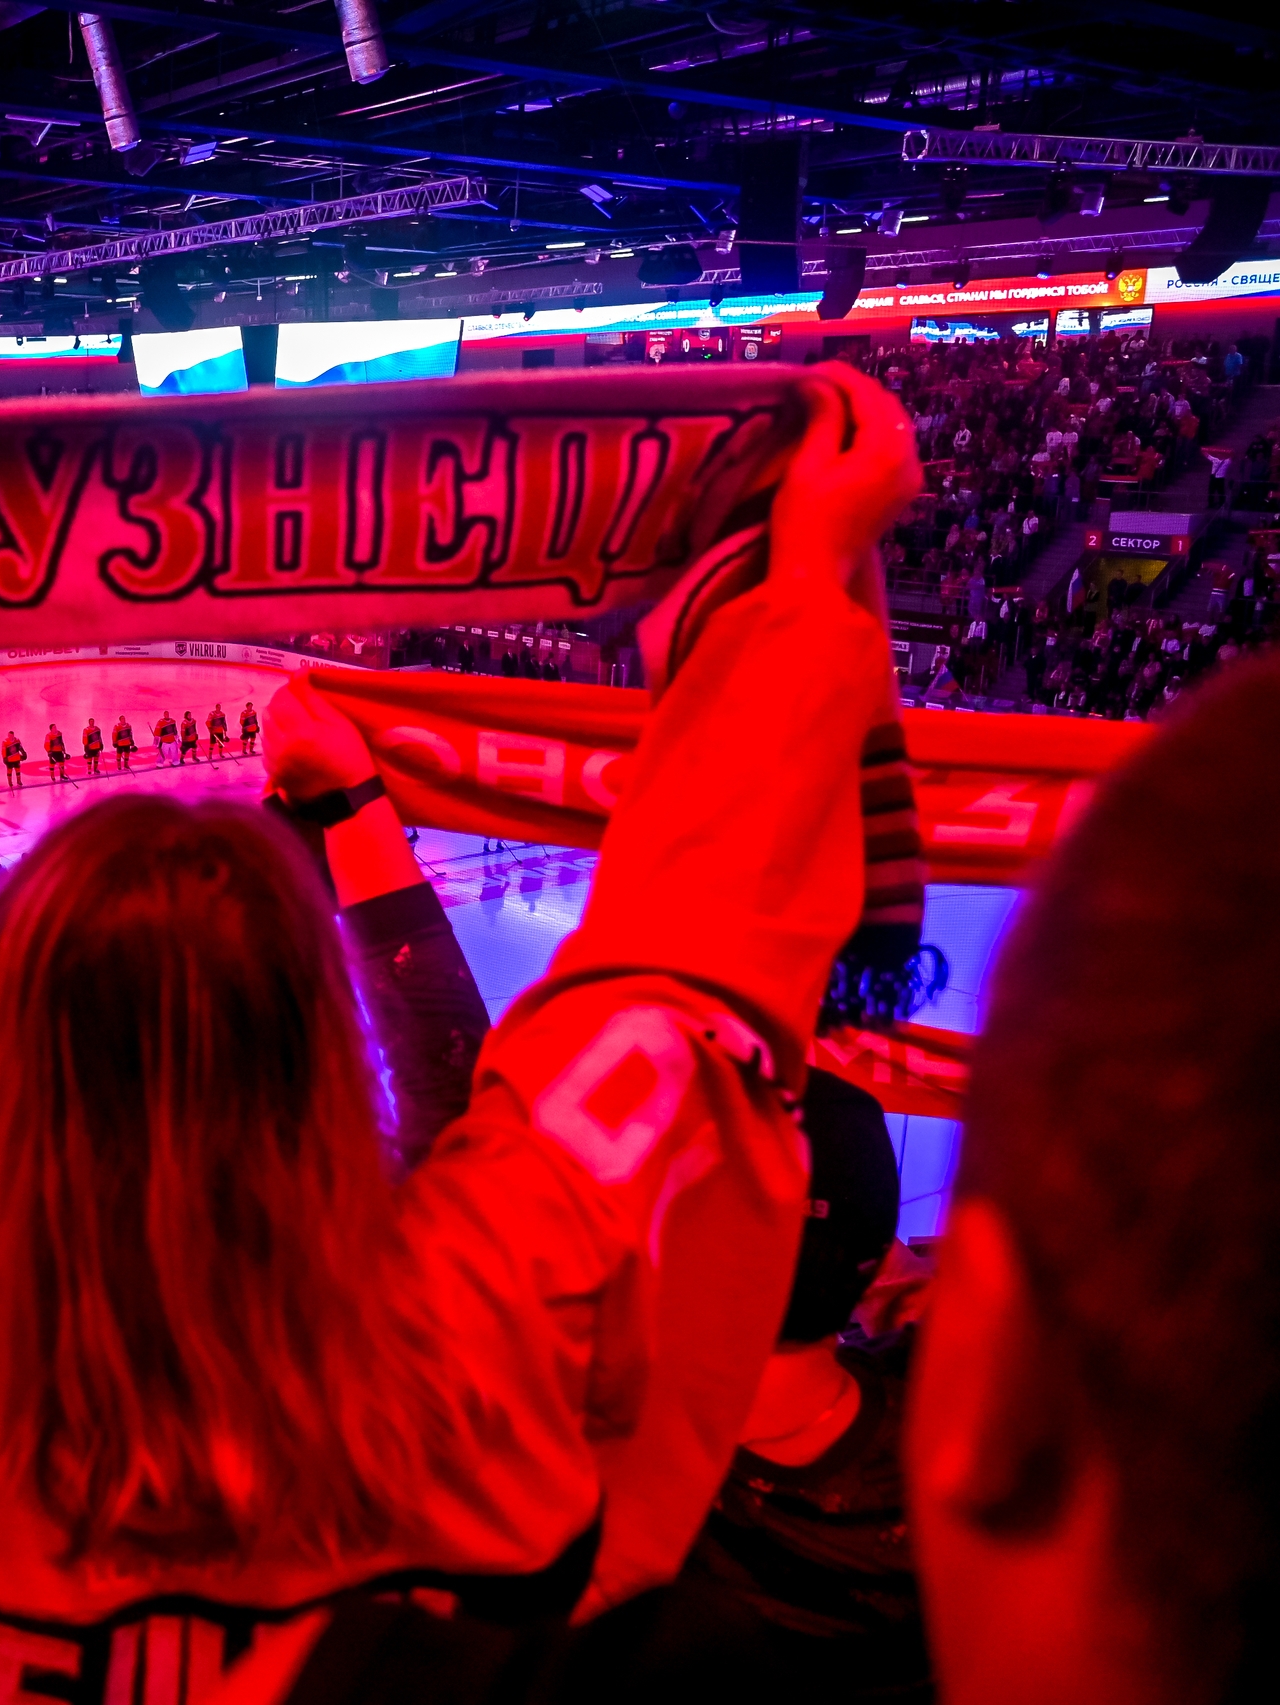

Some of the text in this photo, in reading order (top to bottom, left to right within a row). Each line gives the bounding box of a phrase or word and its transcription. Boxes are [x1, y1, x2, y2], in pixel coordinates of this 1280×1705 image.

[1088, 535, 1183, 552] 2 СЕКТОР 1
[189, 642, 227, 658] VHLRU.RU
